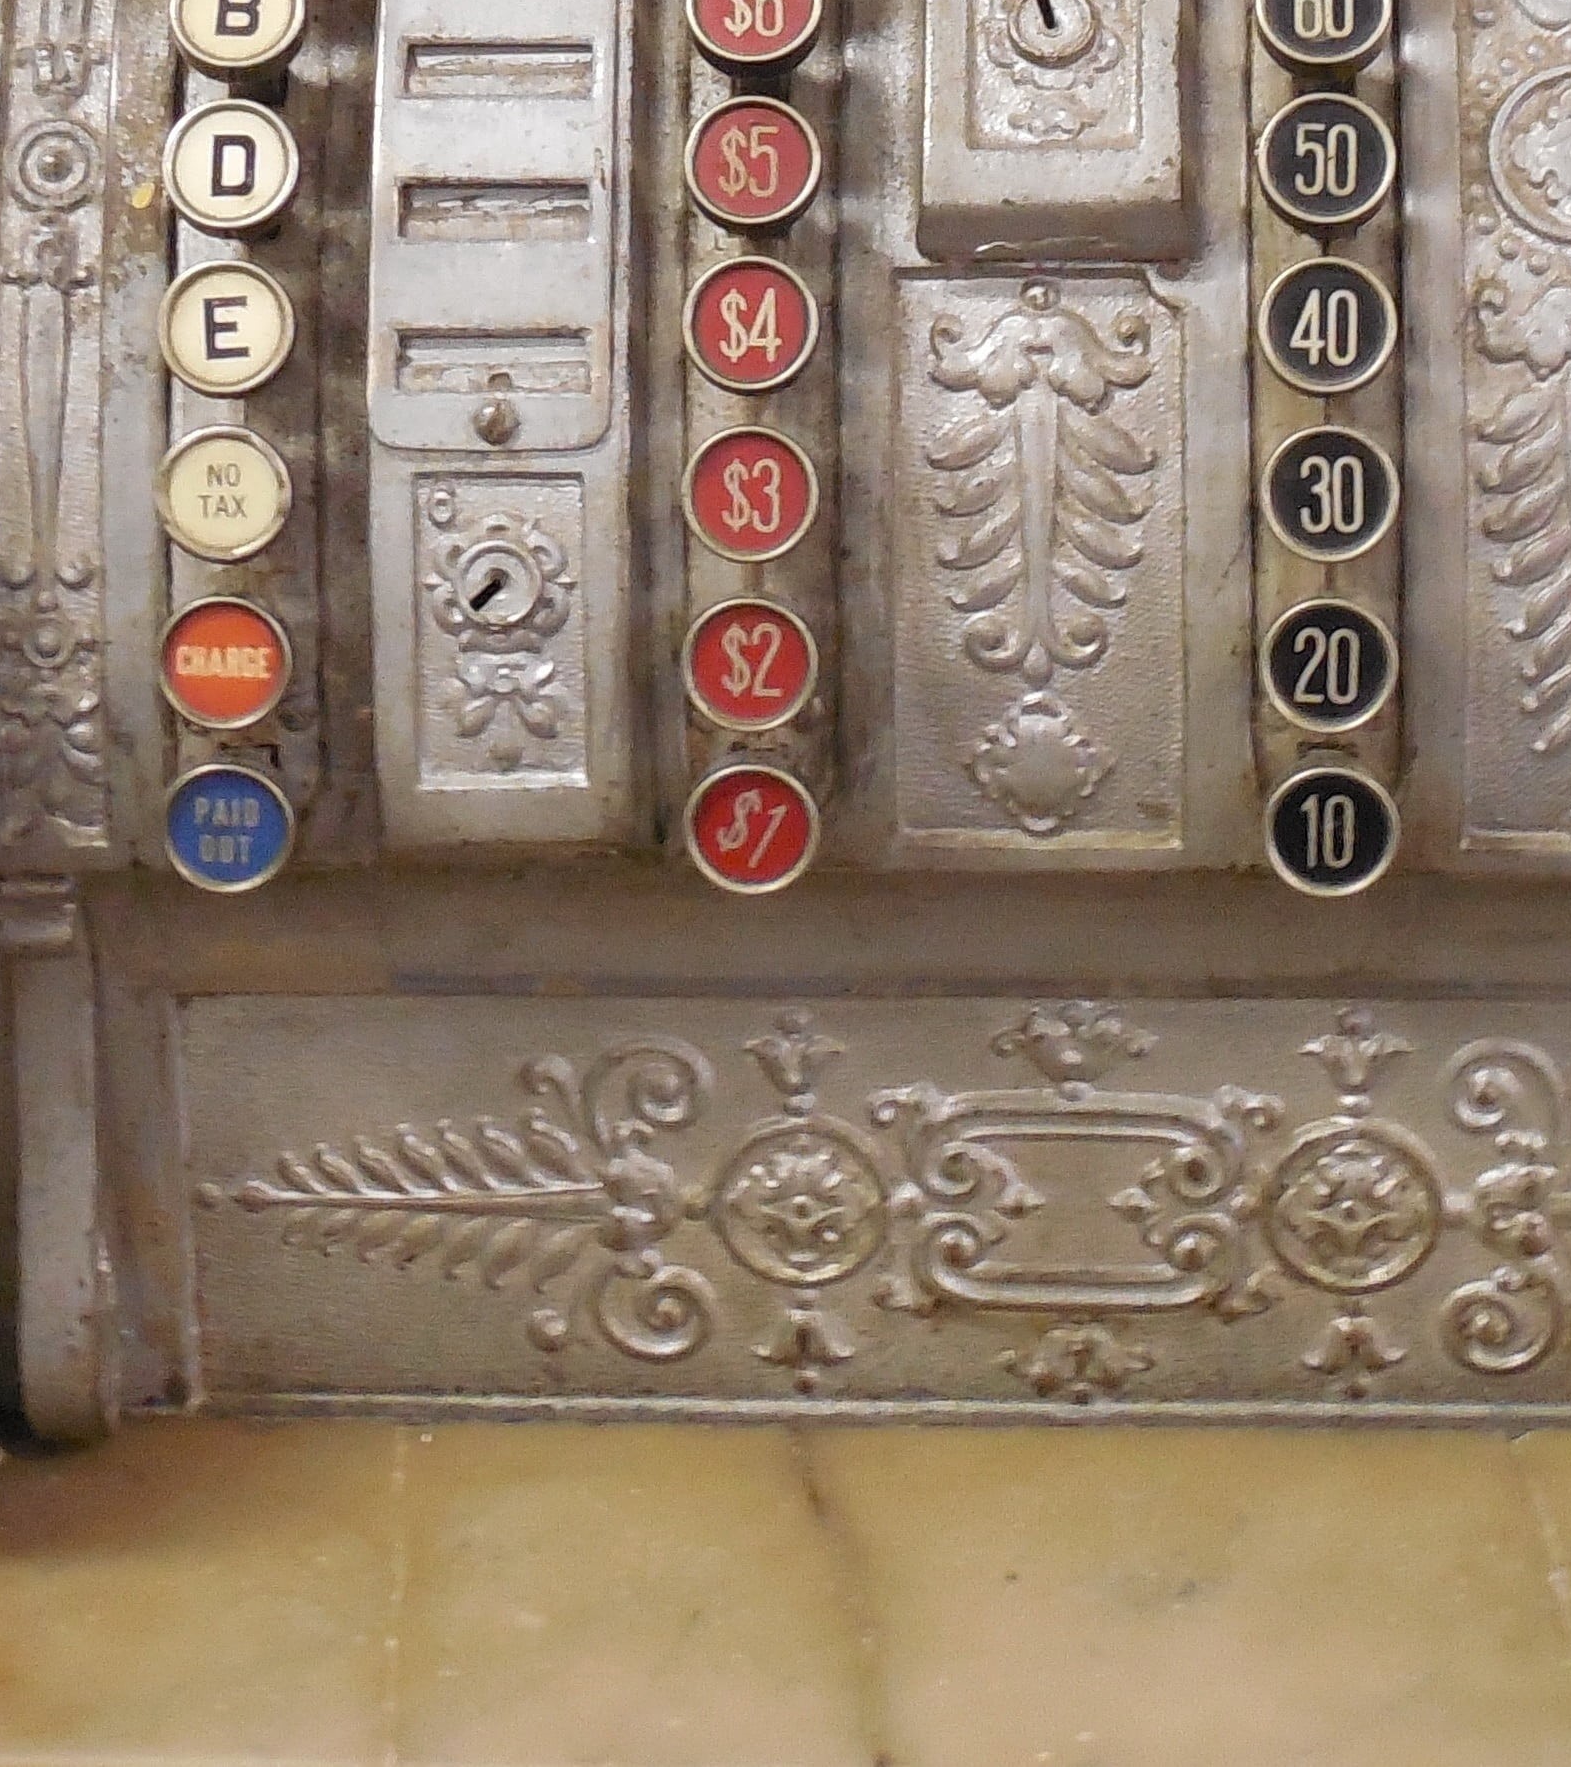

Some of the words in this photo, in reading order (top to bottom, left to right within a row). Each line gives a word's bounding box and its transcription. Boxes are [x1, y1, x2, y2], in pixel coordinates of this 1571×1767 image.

[211, 134, 256, 197] D
[717, 125, 779, 199] $5
[1294, 122, 1358, 198] 50
[202, 295, 250, 361] E
[718, 286, 783, 364] $4
[1289, 286, 1359, 367] 40
[197, 494, 248, 519] TAX
[206, 463, 242, 488] NO
[721, 457, 783, 534] $3
[1299, 455, 1365, 534] 30
[720, 622, 784, 699] $2
[1293, 627, 1362, 706] 20
[194, 796, 261, 827] PAID
[716, 789, 788, 870] $1
[1299, 793, 1357, 870] 10
